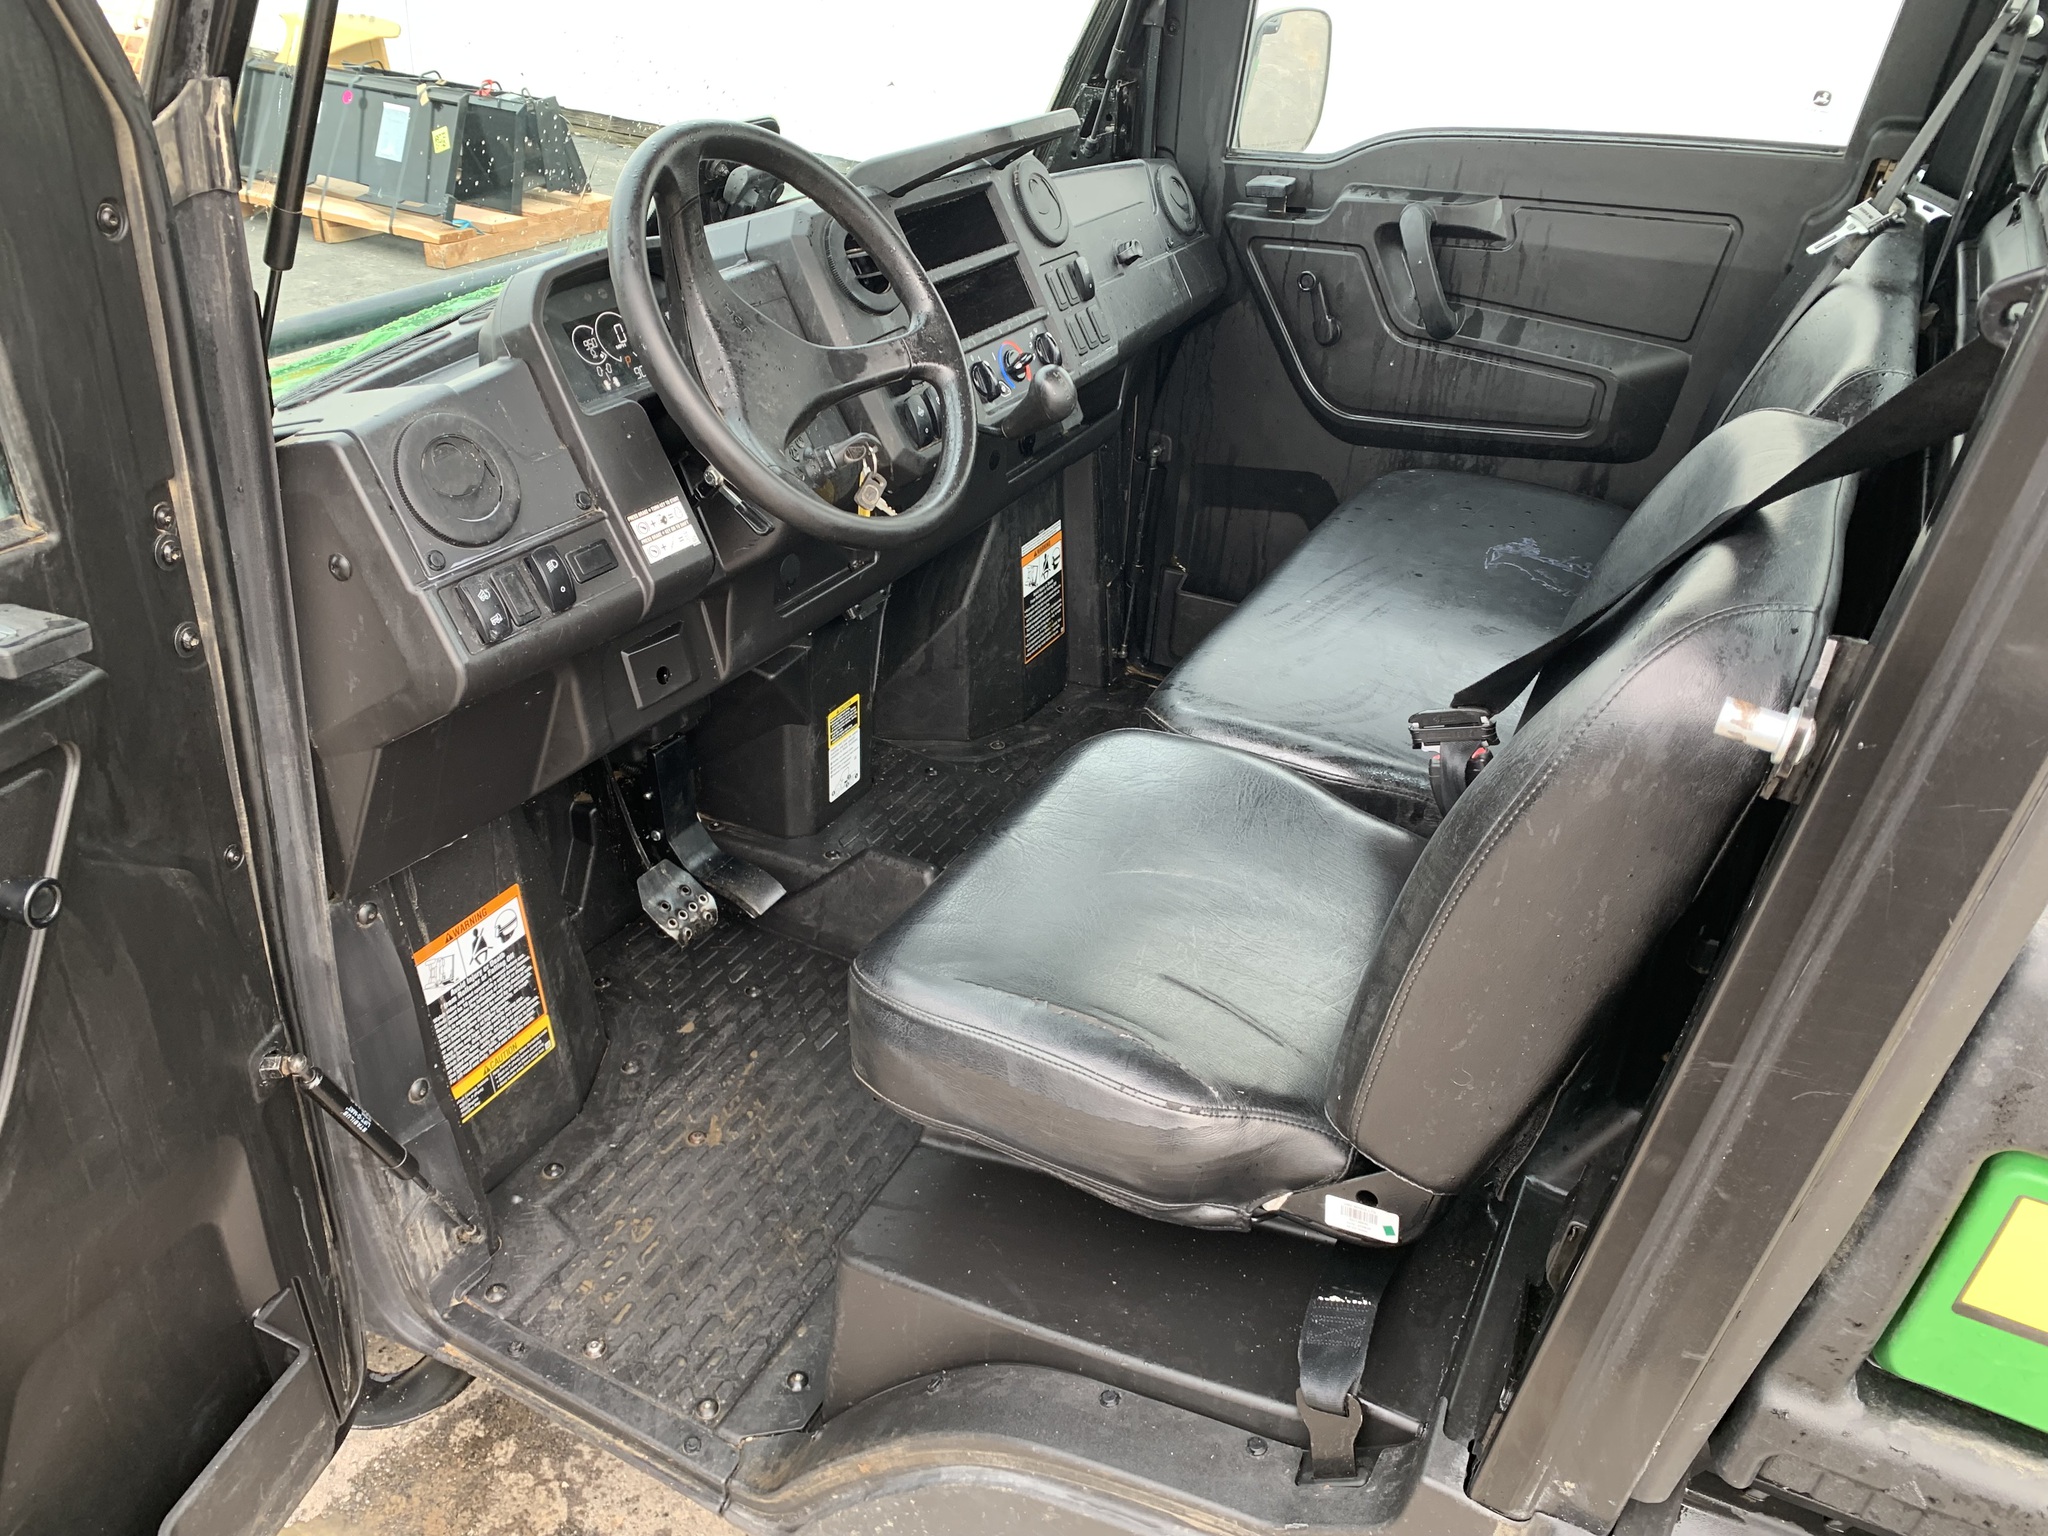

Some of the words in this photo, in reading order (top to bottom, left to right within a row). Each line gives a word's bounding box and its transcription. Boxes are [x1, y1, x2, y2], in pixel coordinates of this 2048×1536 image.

[613, 323, 628, 344] 0
[453, 908, 488, 937] WARNING
[450, 981, 466, 996] Avoid
[491, 1044, 518, 1067] CAUTION
